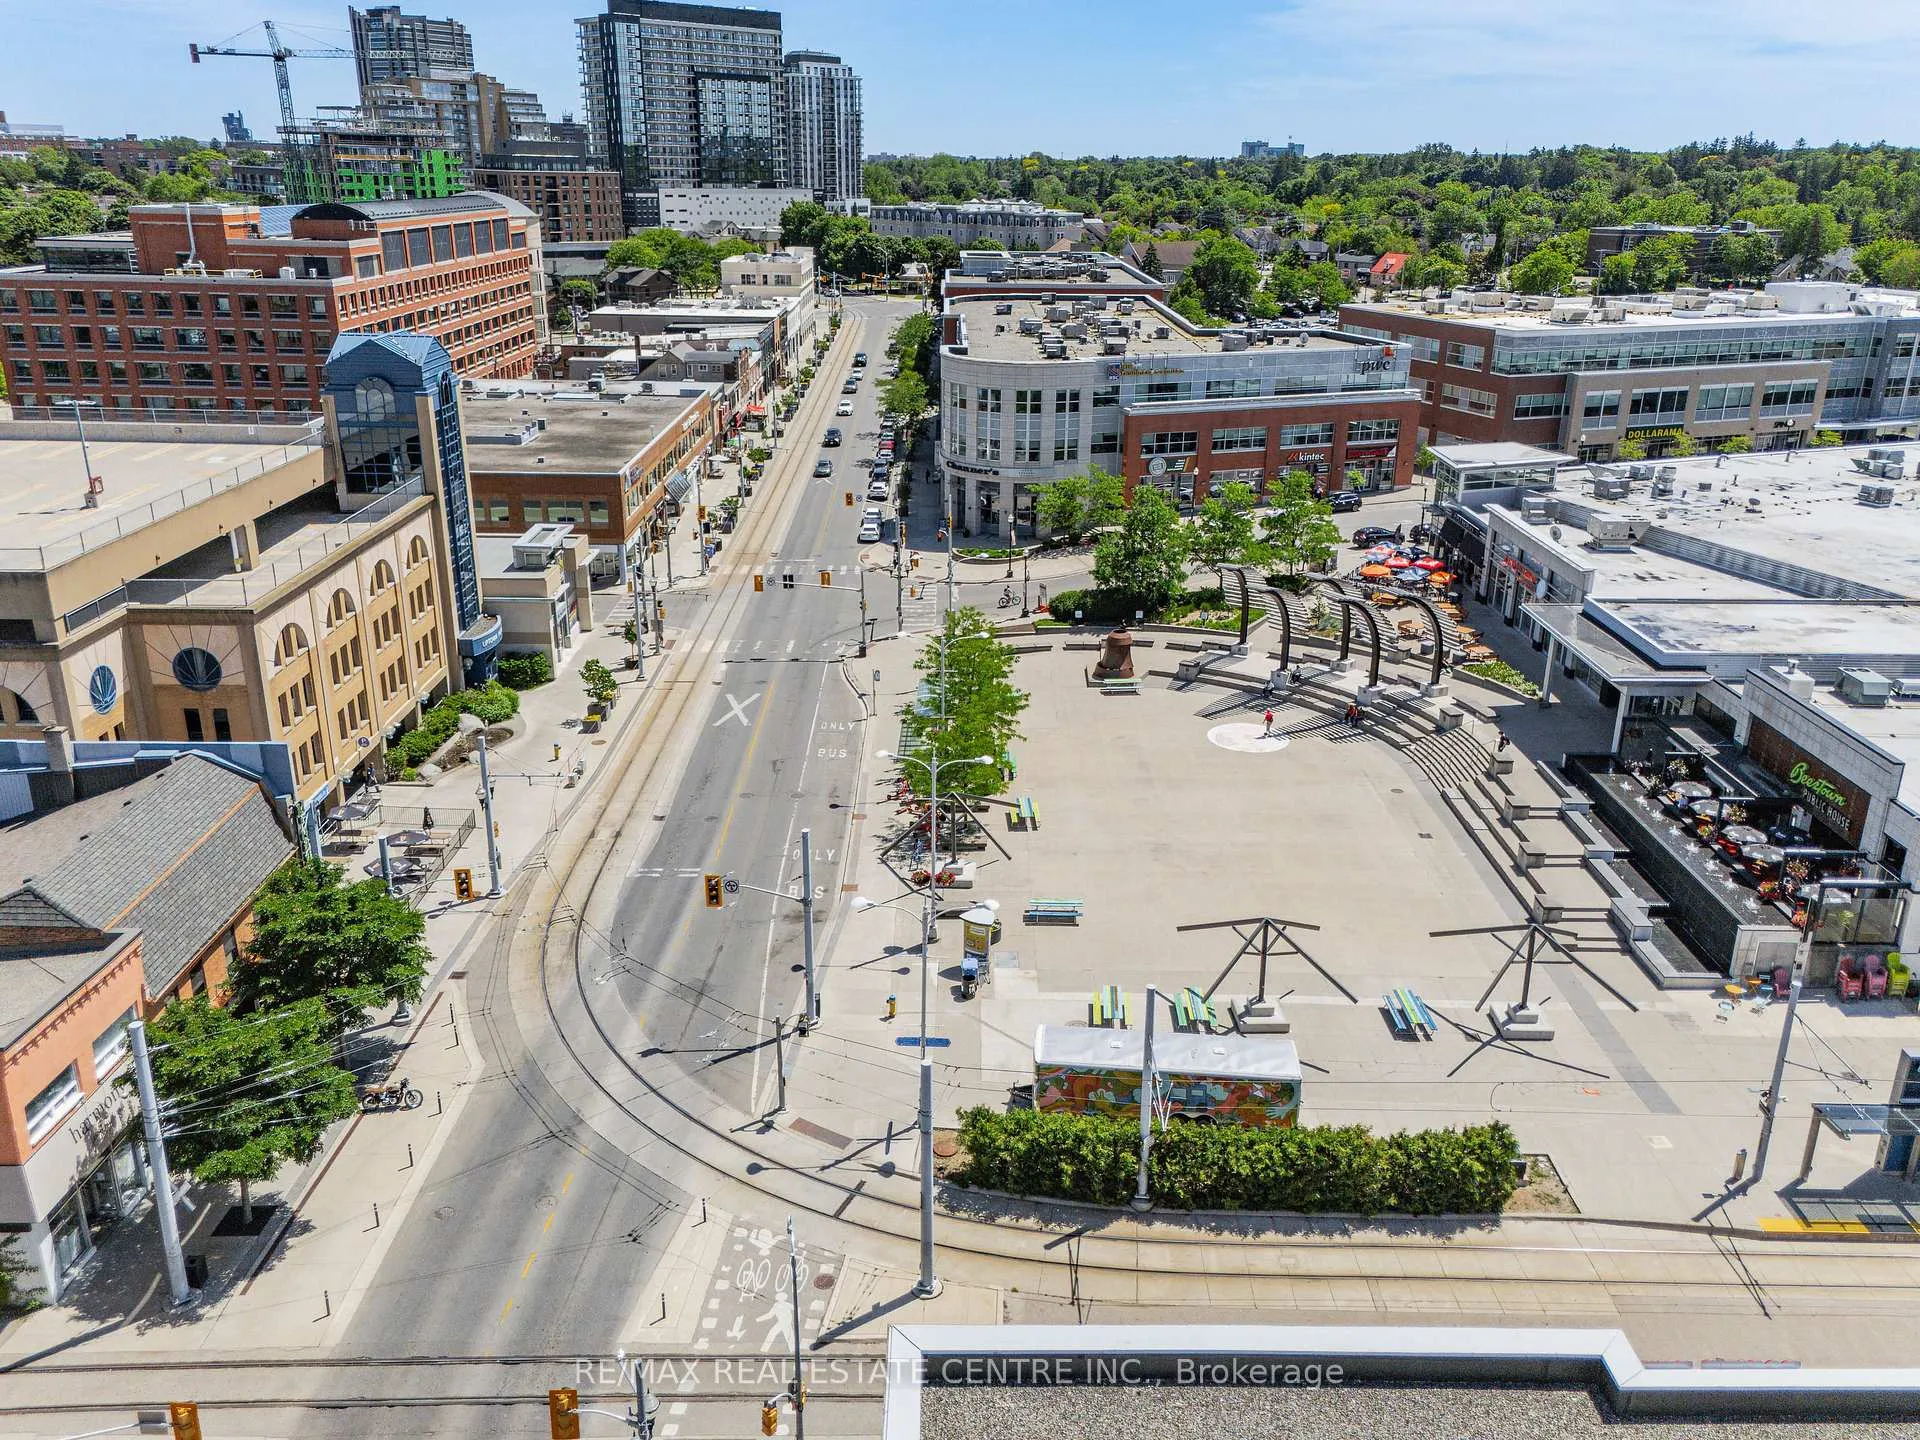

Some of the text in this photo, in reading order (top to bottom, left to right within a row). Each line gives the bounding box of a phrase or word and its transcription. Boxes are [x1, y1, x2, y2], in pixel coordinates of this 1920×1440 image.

[1360, 359, 1391, 375] pwc
[1627, 427, 1682, 439] DOLLARAMA
[1298, 452, 1325, 462] kintec
[820, 721, 856, 731] ONLY
[817, 748, 848, 758] BUS
[1788, 762, 1847, 806] Beertown
[1802, 788, 1851, 831] PUBLIC HOUSE
[792, 848, 836, 861] OLY
[789, 885, 825, 899] BS
